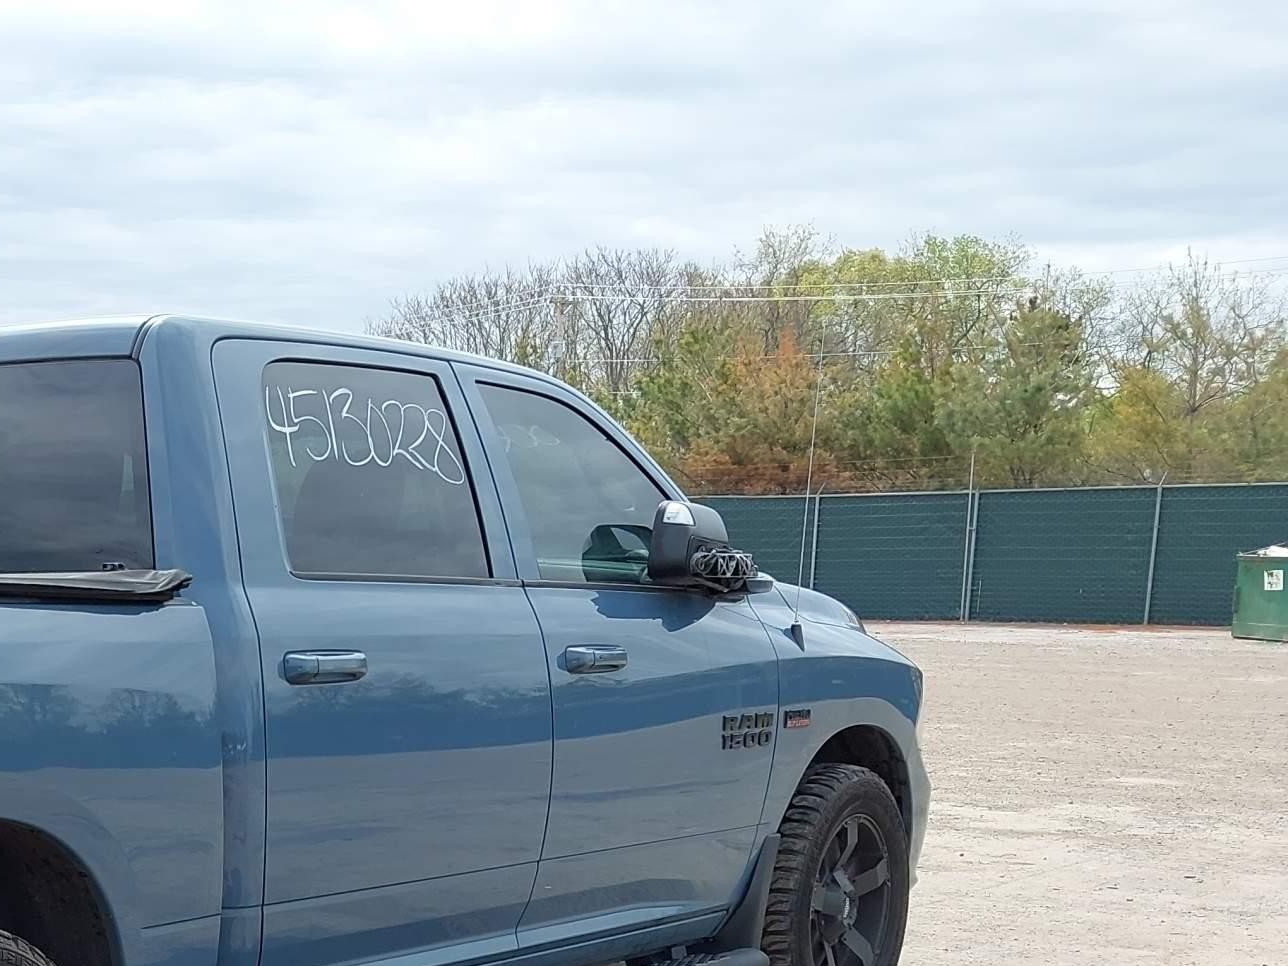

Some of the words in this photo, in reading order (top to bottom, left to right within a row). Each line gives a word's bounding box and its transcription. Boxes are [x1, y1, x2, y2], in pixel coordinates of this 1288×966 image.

[265, 386, 465, 484] 45130228
[722, 712, 774, 732] RAM
[721, 730, 772, 750] 1500
